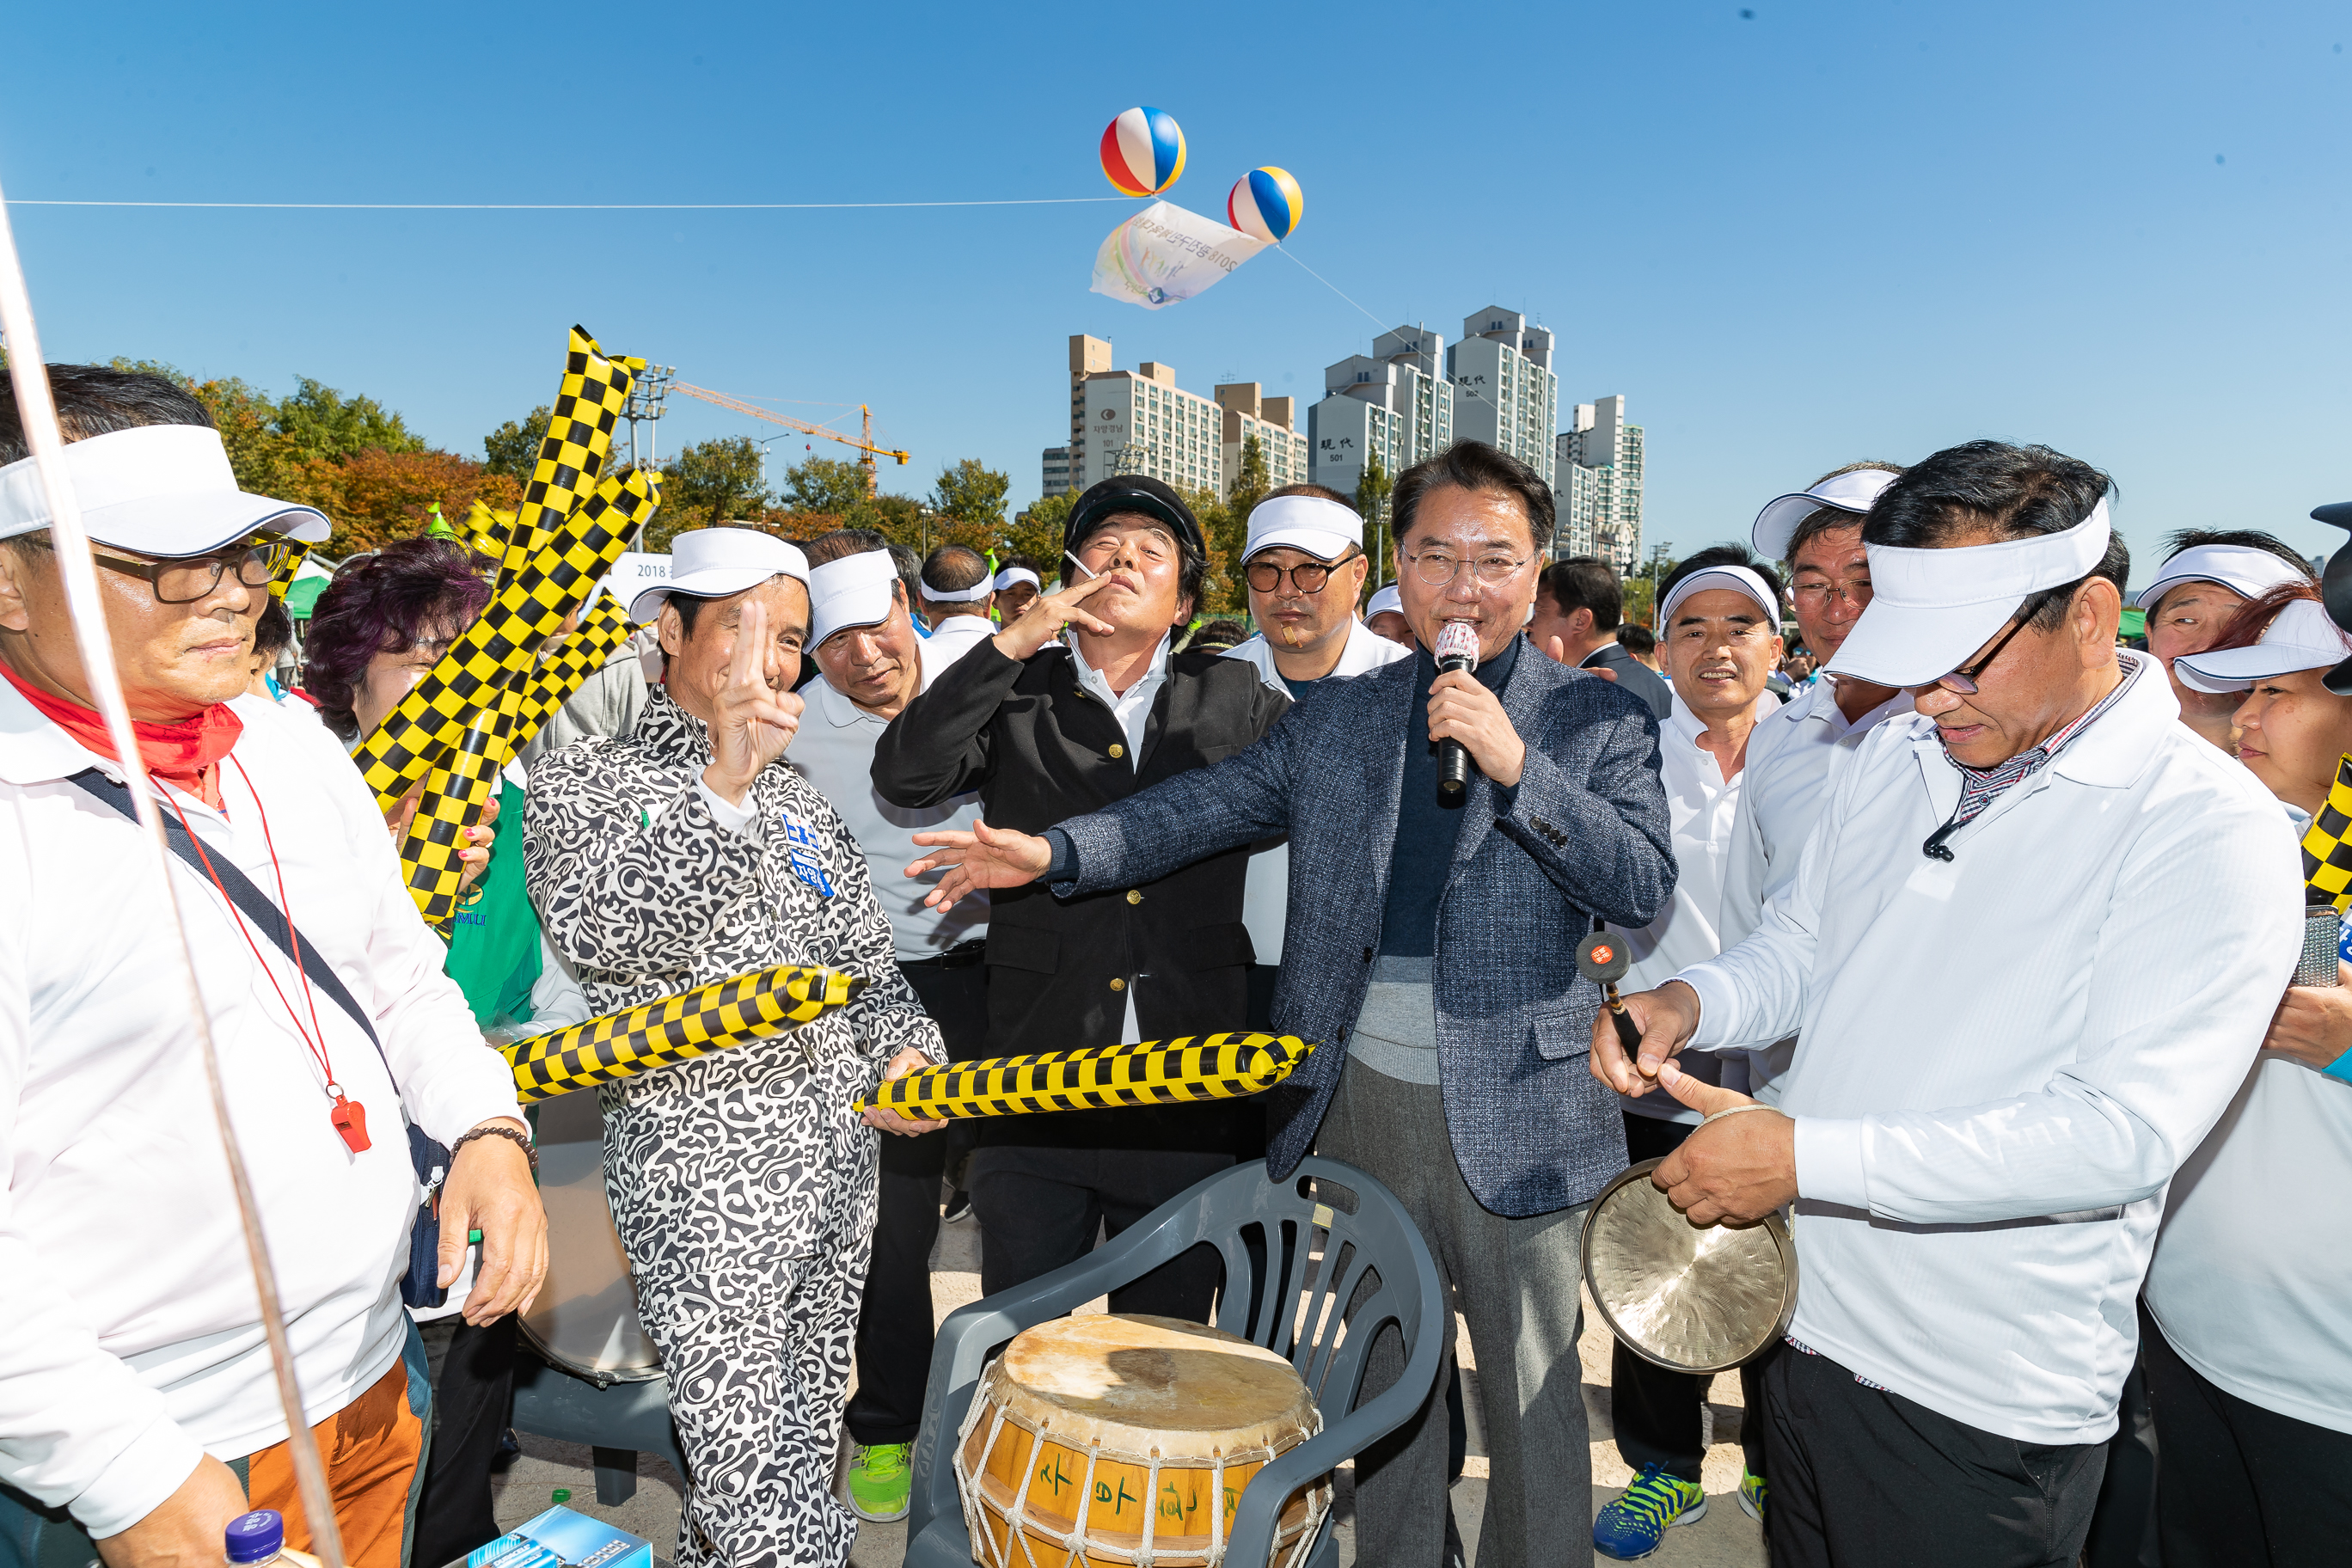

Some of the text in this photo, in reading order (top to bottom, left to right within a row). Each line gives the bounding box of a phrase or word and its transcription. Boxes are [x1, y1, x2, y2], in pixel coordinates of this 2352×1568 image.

[1320, 437, 1354, 450] 現代
[637, 564, 665, 578] 2018
[452, 912, 487, 927] MU
[493, 1544, 530, 1567] DURACELL
